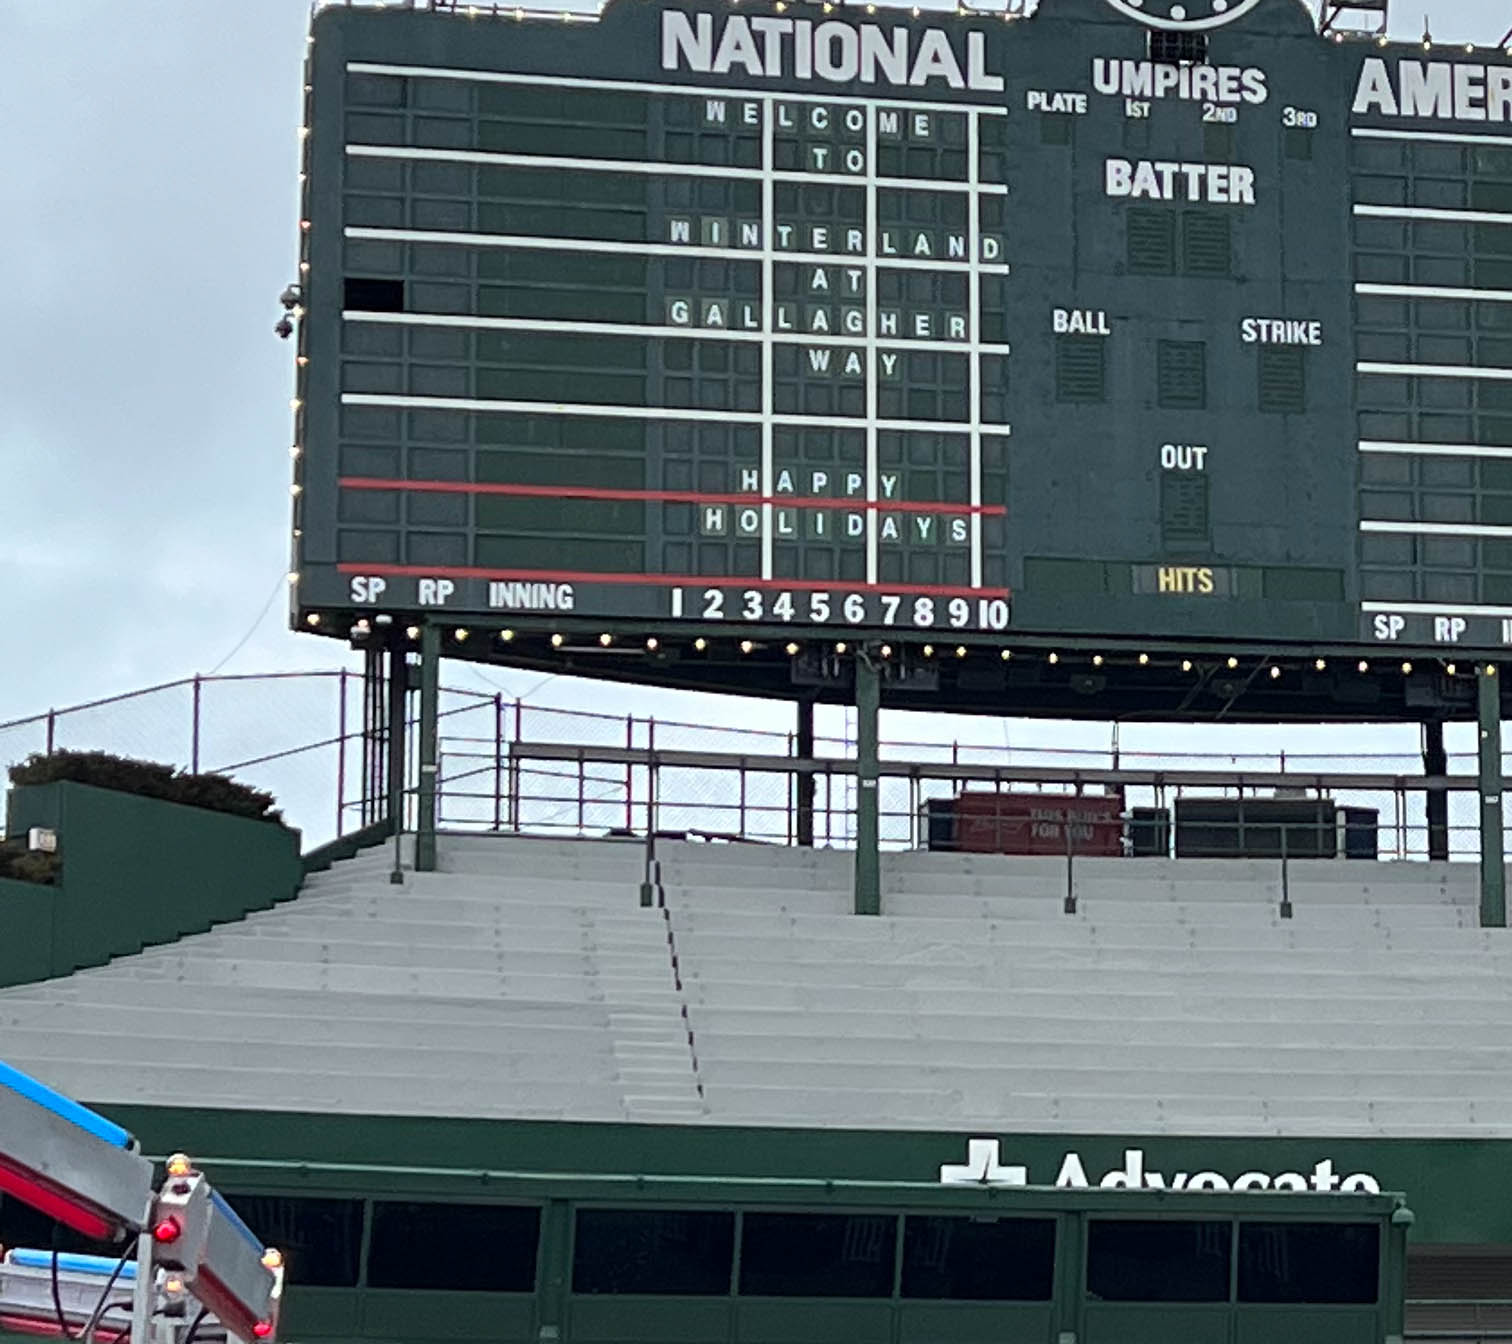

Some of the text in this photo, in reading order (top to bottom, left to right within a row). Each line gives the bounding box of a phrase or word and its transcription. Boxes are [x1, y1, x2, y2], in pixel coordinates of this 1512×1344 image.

[663, 10, 1005, 92] NATIONAL
[1093, 58, 1268, 105] UMPIRES
[706, 100, 929, 137] WELCOME
[1027, 91, 1318, 128] PLATE 1ST 2ND 3RD
[812, 147, 864, 173] TO
[1106, 159, 1256, 205] BATTER
[670, 220, 1000, 260] WINTERLAND
[812, 268, 863, 292] AT
[671, 301, 966, 340] GALLAGHER
[1053, 309, 1111, 335] BALL
[1241, 318, 1322, 345] STRIKE
[808, 349, 898, 375] WAY
[1161, 444, 1208, 470] OUT
[742, 469, 898, 498] HAPPY
[705, 507, 968, 541] HOLIDAYS
[1158, 567, 1214, 594] HITS
[351, 576, 1009, 630] SP RP INNING 1 2 3 4 5 6 7 8 9 10
[1373, 614, 1405, 641] SP
[1434, 616, 1466, 643] RP
